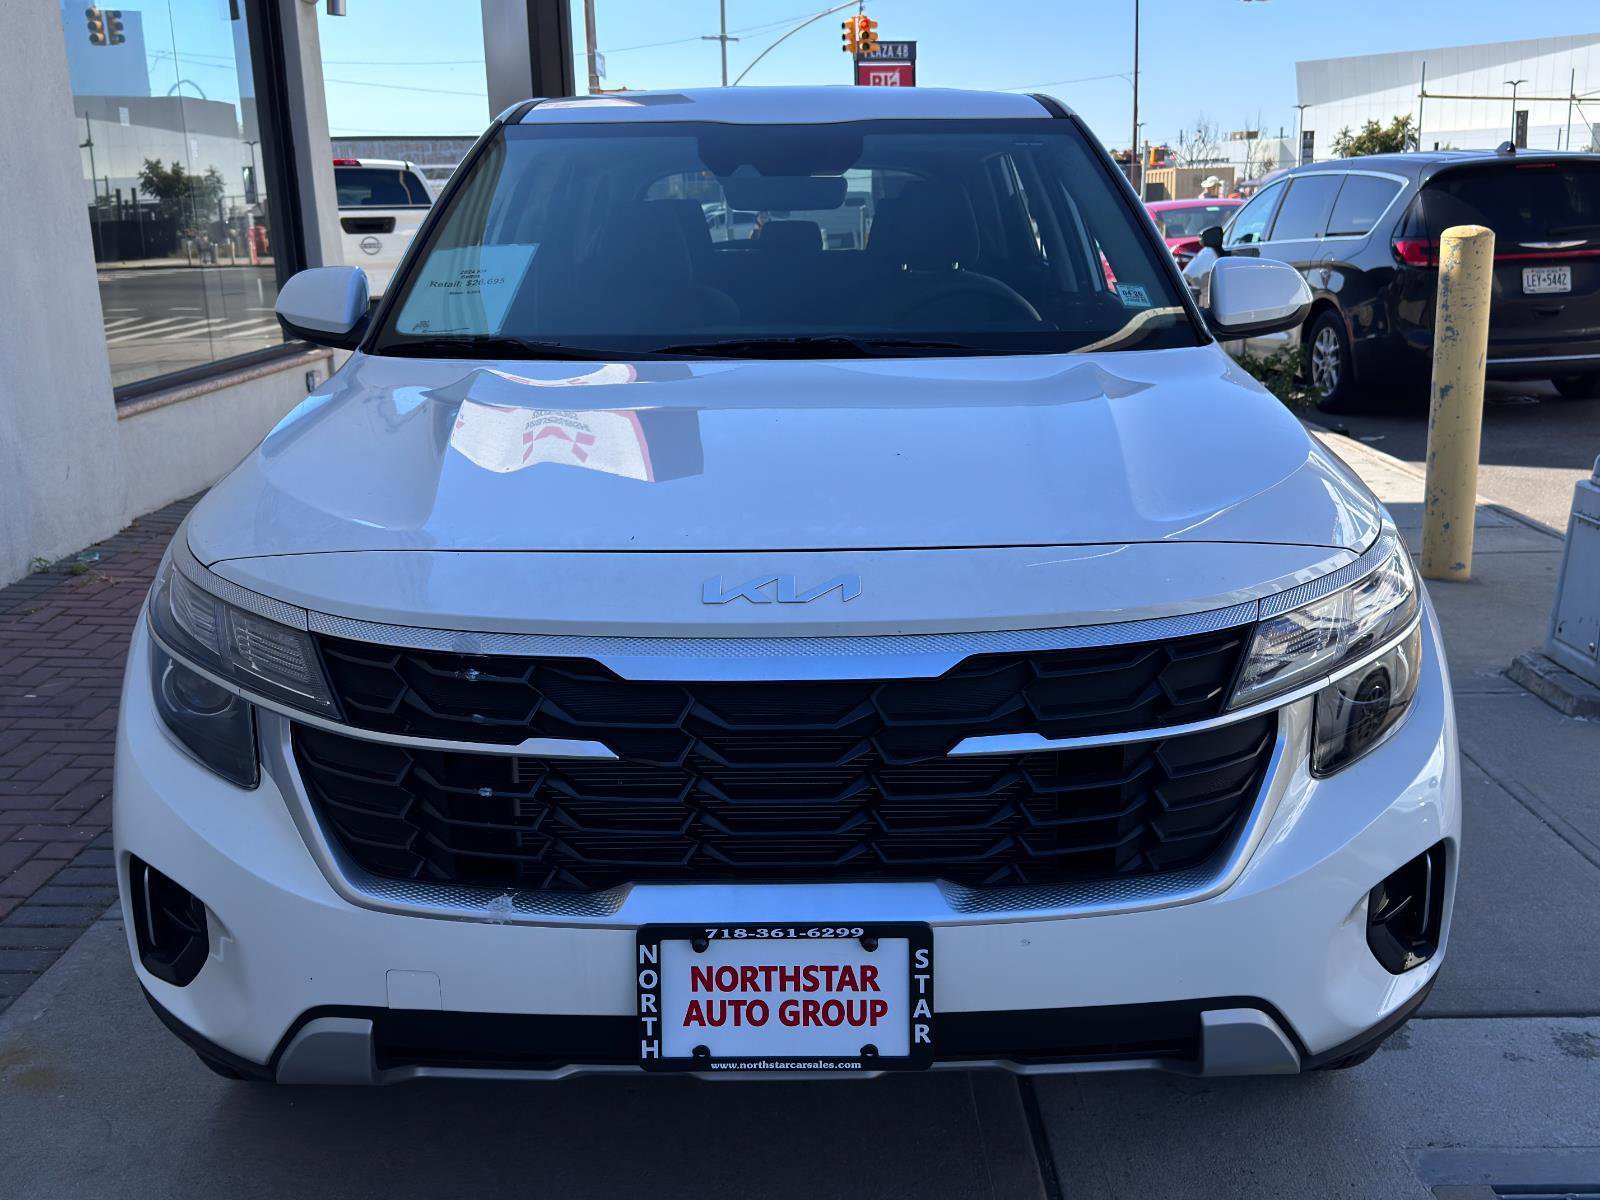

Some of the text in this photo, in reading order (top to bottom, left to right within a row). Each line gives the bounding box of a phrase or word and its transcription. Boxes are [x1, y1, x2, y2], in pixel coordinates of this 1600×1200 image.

[896, 44, 909, 57] 48
[705, 927, 864, 939] 718-361-6299
[690, 965, 880, 993] NORTHSTAR
[638, 944, 659, 1059] NORTH
[913, 949, 932, 1044] STAR
[683, 999, 889, 1027] AUTO GROUP
[710, 1060, 862, 1070] www.northstarcarsales.com
